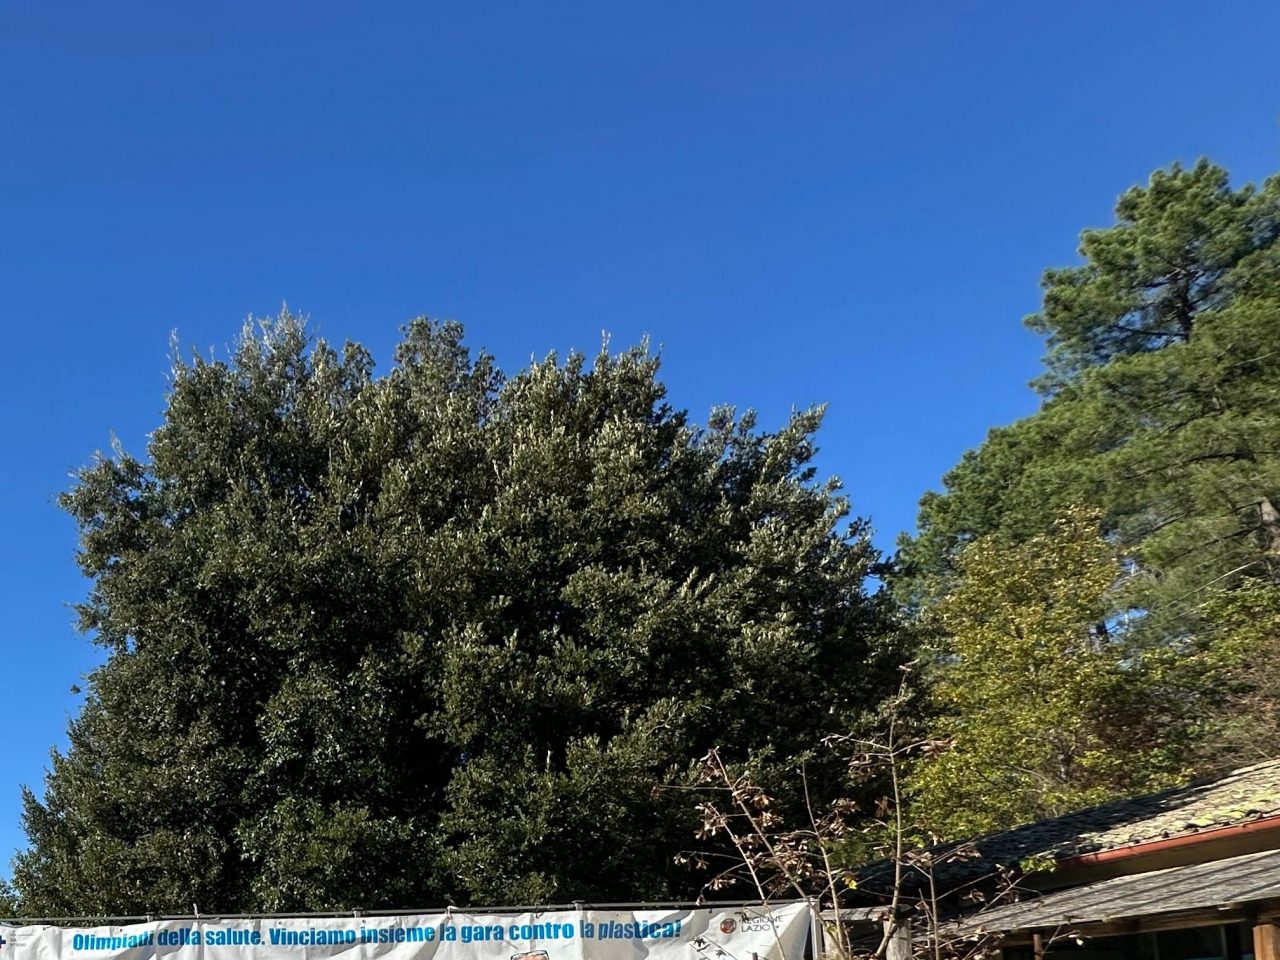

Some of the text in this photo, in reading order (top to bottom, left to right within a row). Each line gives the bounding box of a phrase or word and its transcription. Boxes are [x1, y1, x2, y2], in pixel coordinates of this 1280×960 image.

[73, 919, 681, 951] Olimpiadi della salute. Vinciamo insieme la gara contro la plastica!
[741, 923, 770, 933] LAZIO
